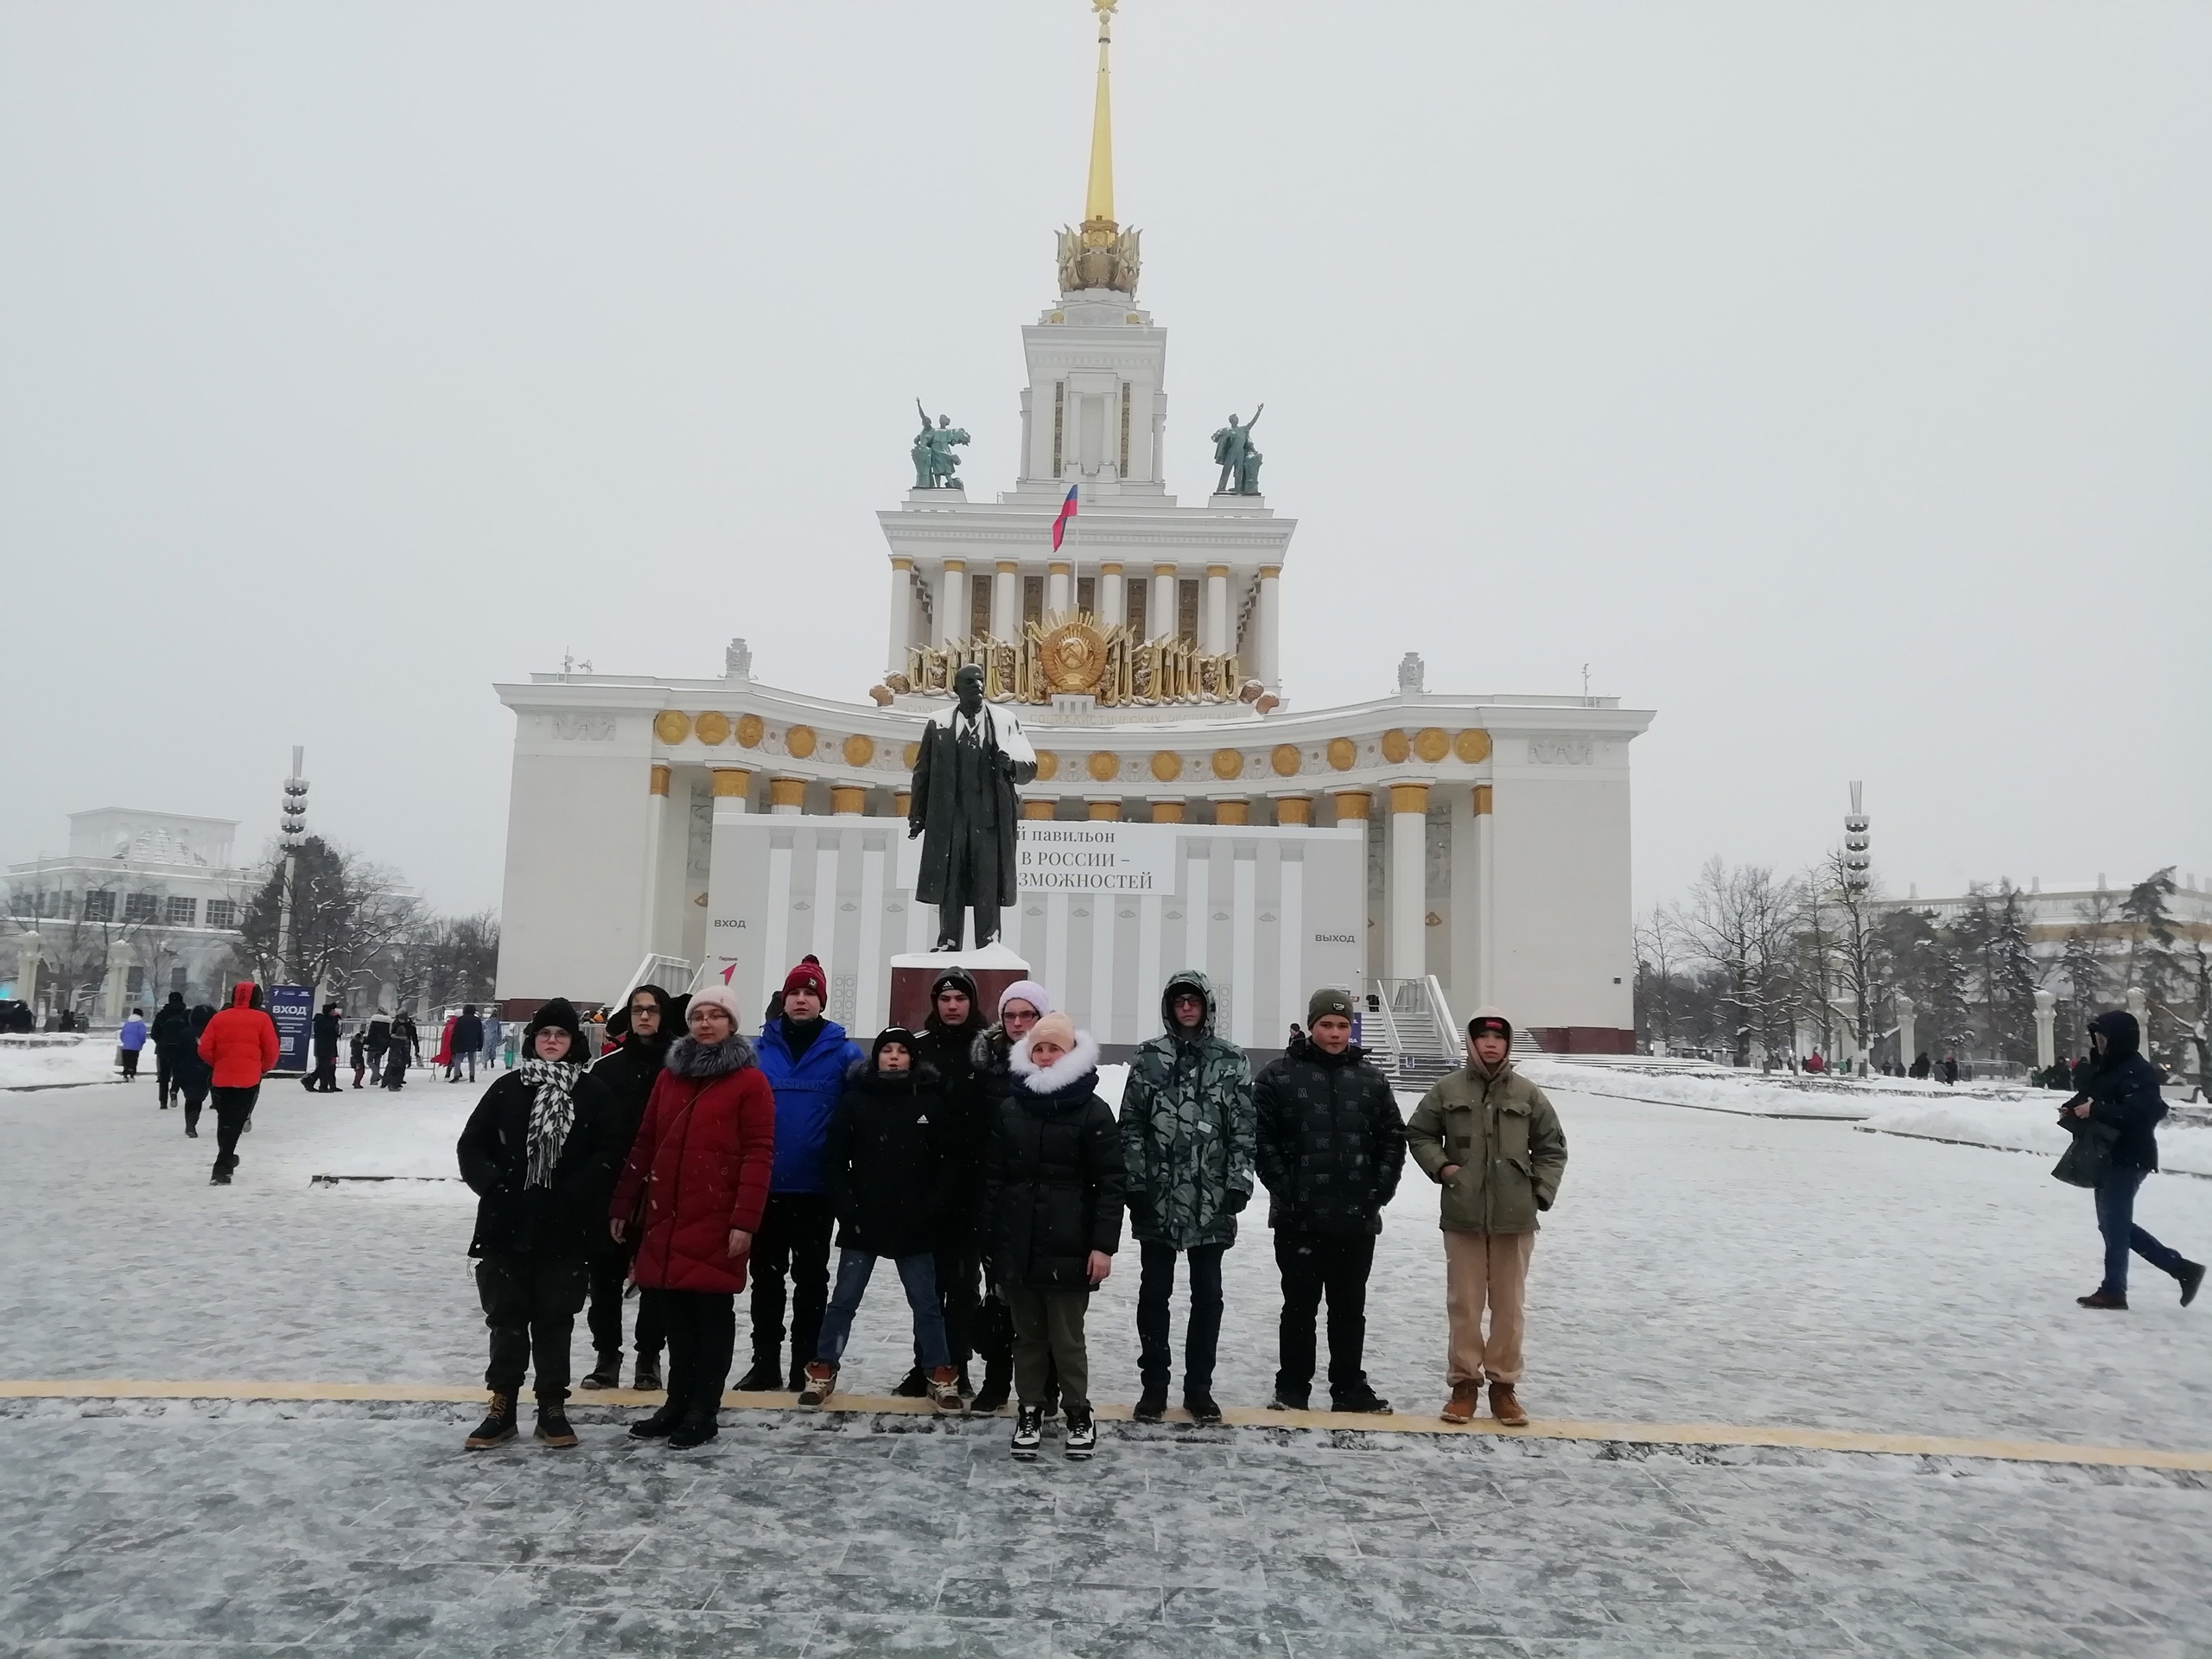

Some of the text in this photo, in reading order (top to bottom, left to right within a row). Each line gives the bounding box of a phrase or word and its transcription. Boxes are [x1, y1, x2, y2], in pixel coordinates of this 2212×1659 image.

[1032, 830, 1116, 843] павильон
[1021, 851, 1032, 865] В
[1038, 851, 1116, 868] РОССИИ
[1018, 871, 1153, 889] ЗМОЖНОСТЕЙ
[714, 919, 747, 929] ВХОД
[1315, 934, 1356, 943] ВЫХОД
[272, 1005, 307, 1016] ВХОД
